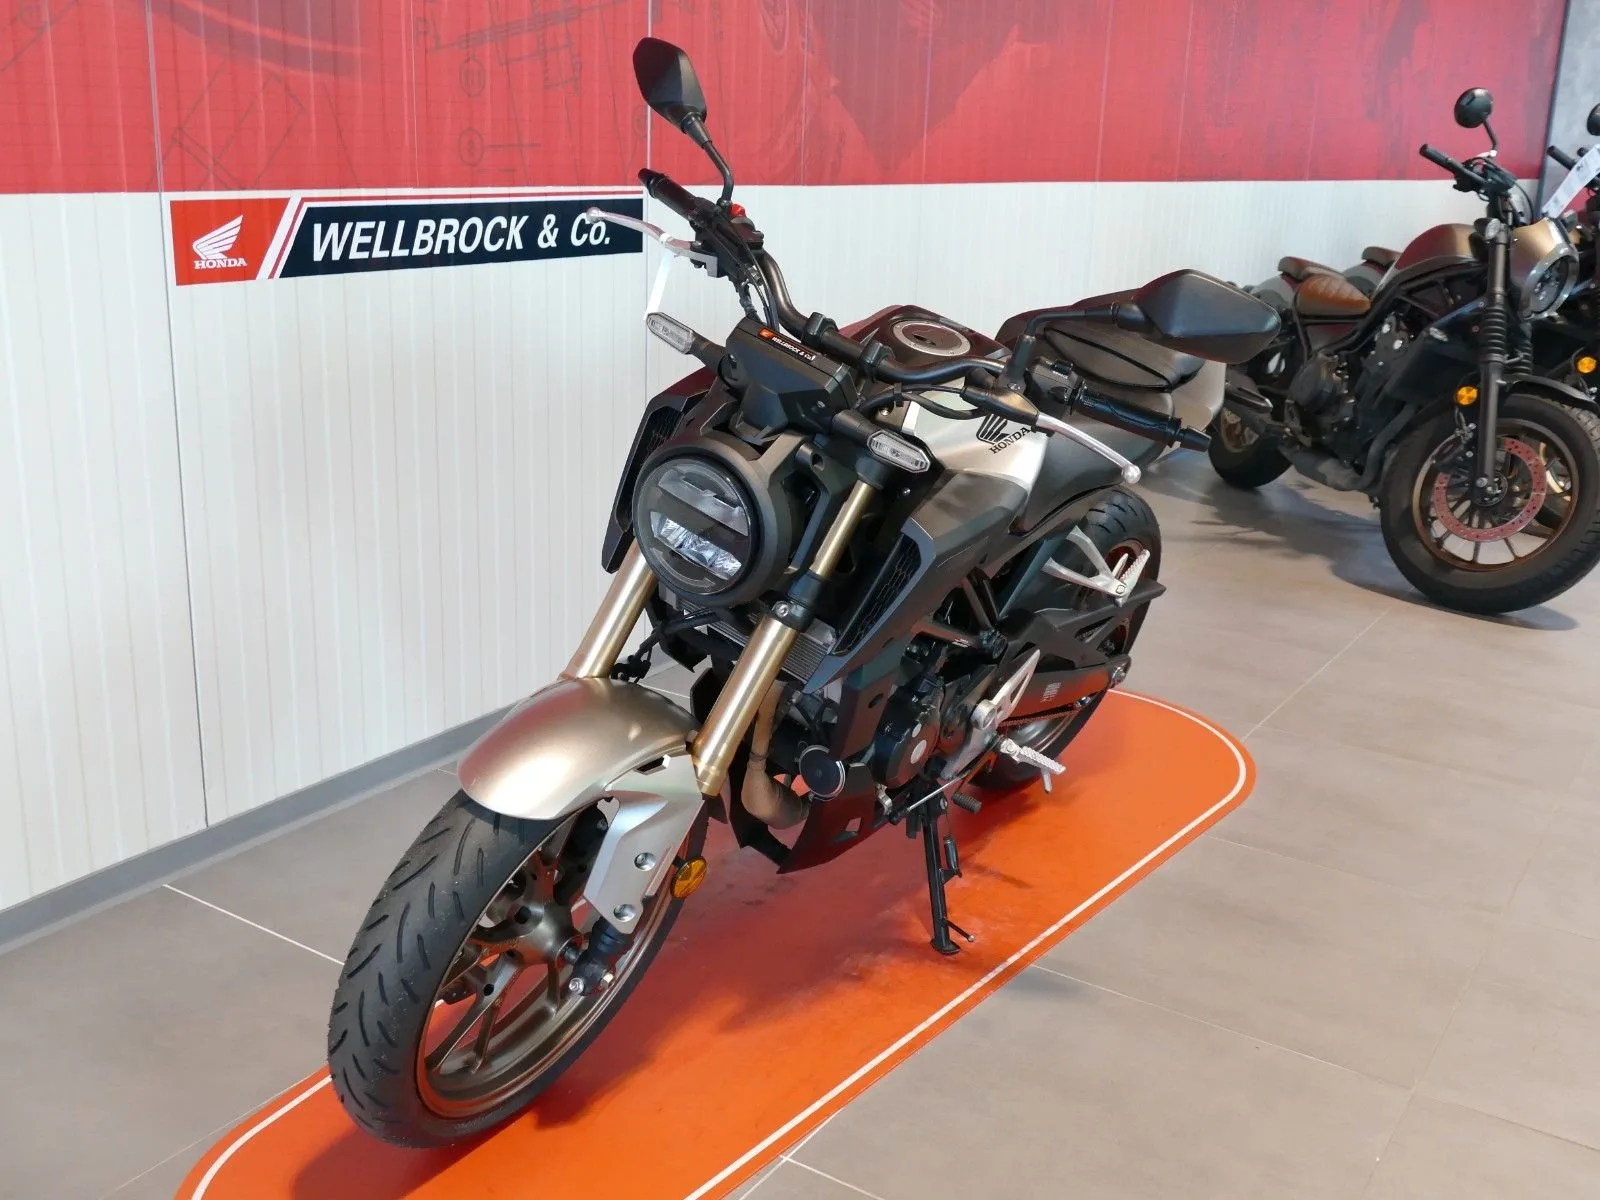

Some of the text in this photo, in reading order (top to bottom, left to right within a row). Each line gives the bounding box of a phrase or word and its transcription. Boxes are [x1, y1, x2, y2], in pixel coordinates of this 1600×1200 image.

[312, 212, 610, 262] WELLBROCK & Co.
[194, 257, 247, 269] HONDA
[989, 426, 1031, 454] HONDA
